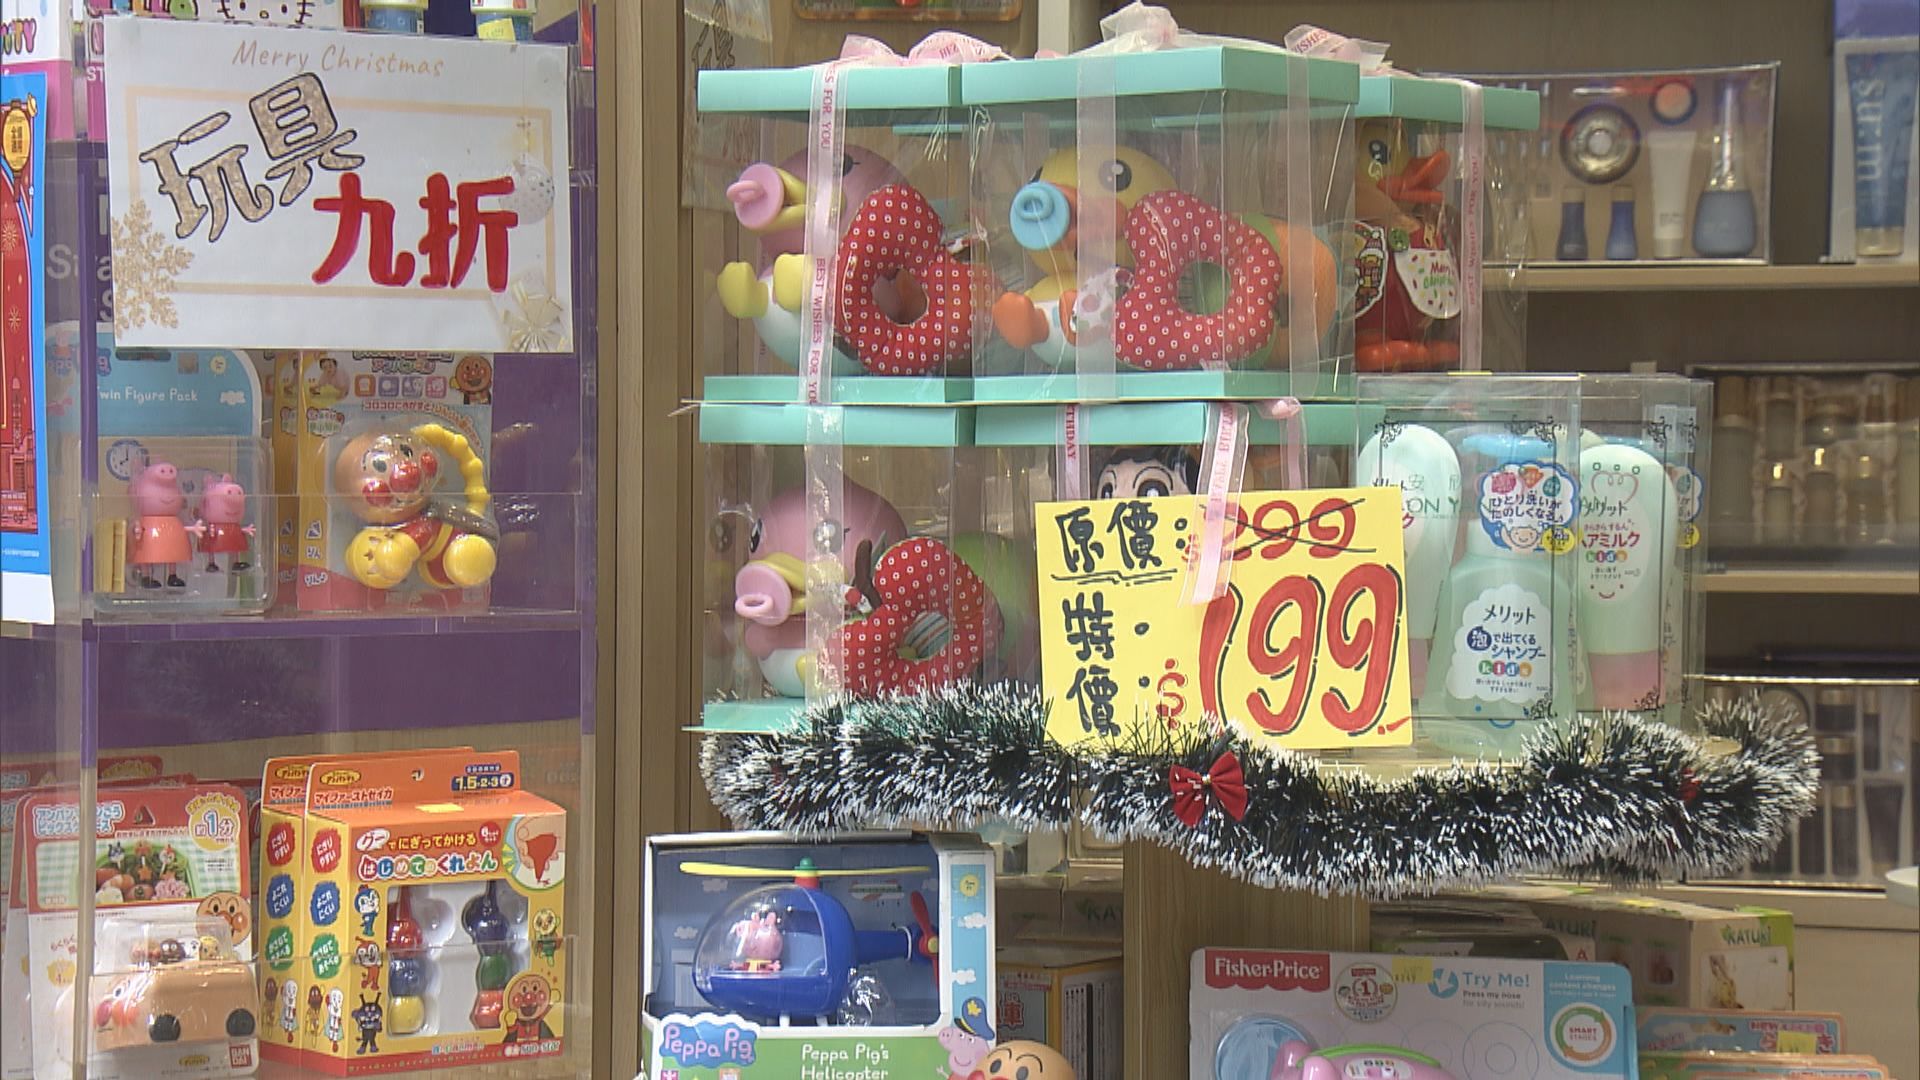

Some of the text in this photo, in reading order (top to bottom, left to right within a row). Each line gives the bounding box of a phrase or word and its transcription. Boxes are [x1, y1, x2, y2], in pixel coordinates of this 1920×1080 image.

[231, 39, 445, 77] Merry Christmas
[822, 89, 833, 114] FOR
[821, 122, 832, 150] YOU
[140, 73, 364, 242] 玩具
[312, 171, 518, 292] 九折
[816, 258, 825, 289] BEST
[813, 296, 823, 344] WISHES
[809, 350, 820, 375] FOR
[97, 386, 198, 405] win Figure Pack
[1483, 604, 1536, 625] メリット
[1492, 645, 1547, 661] シャンプー
[359, 830, 477, 852] グーでにぎってかける
[360, 852, 498, 880] はじめてのくれよん
[1463, 972, 1531, 989] Try Me!
[1463, 991, 1484, 1000] Press
[1487, 992, 1499, 1001] my
[665, 1024, 755, 1063] Peppa Pig
[1569, 1029, 1597, 1037] SMART
[802, 1043, 889, 1066] Peppa Pig's
[802, 1065, 889, 1080] Helicopter
